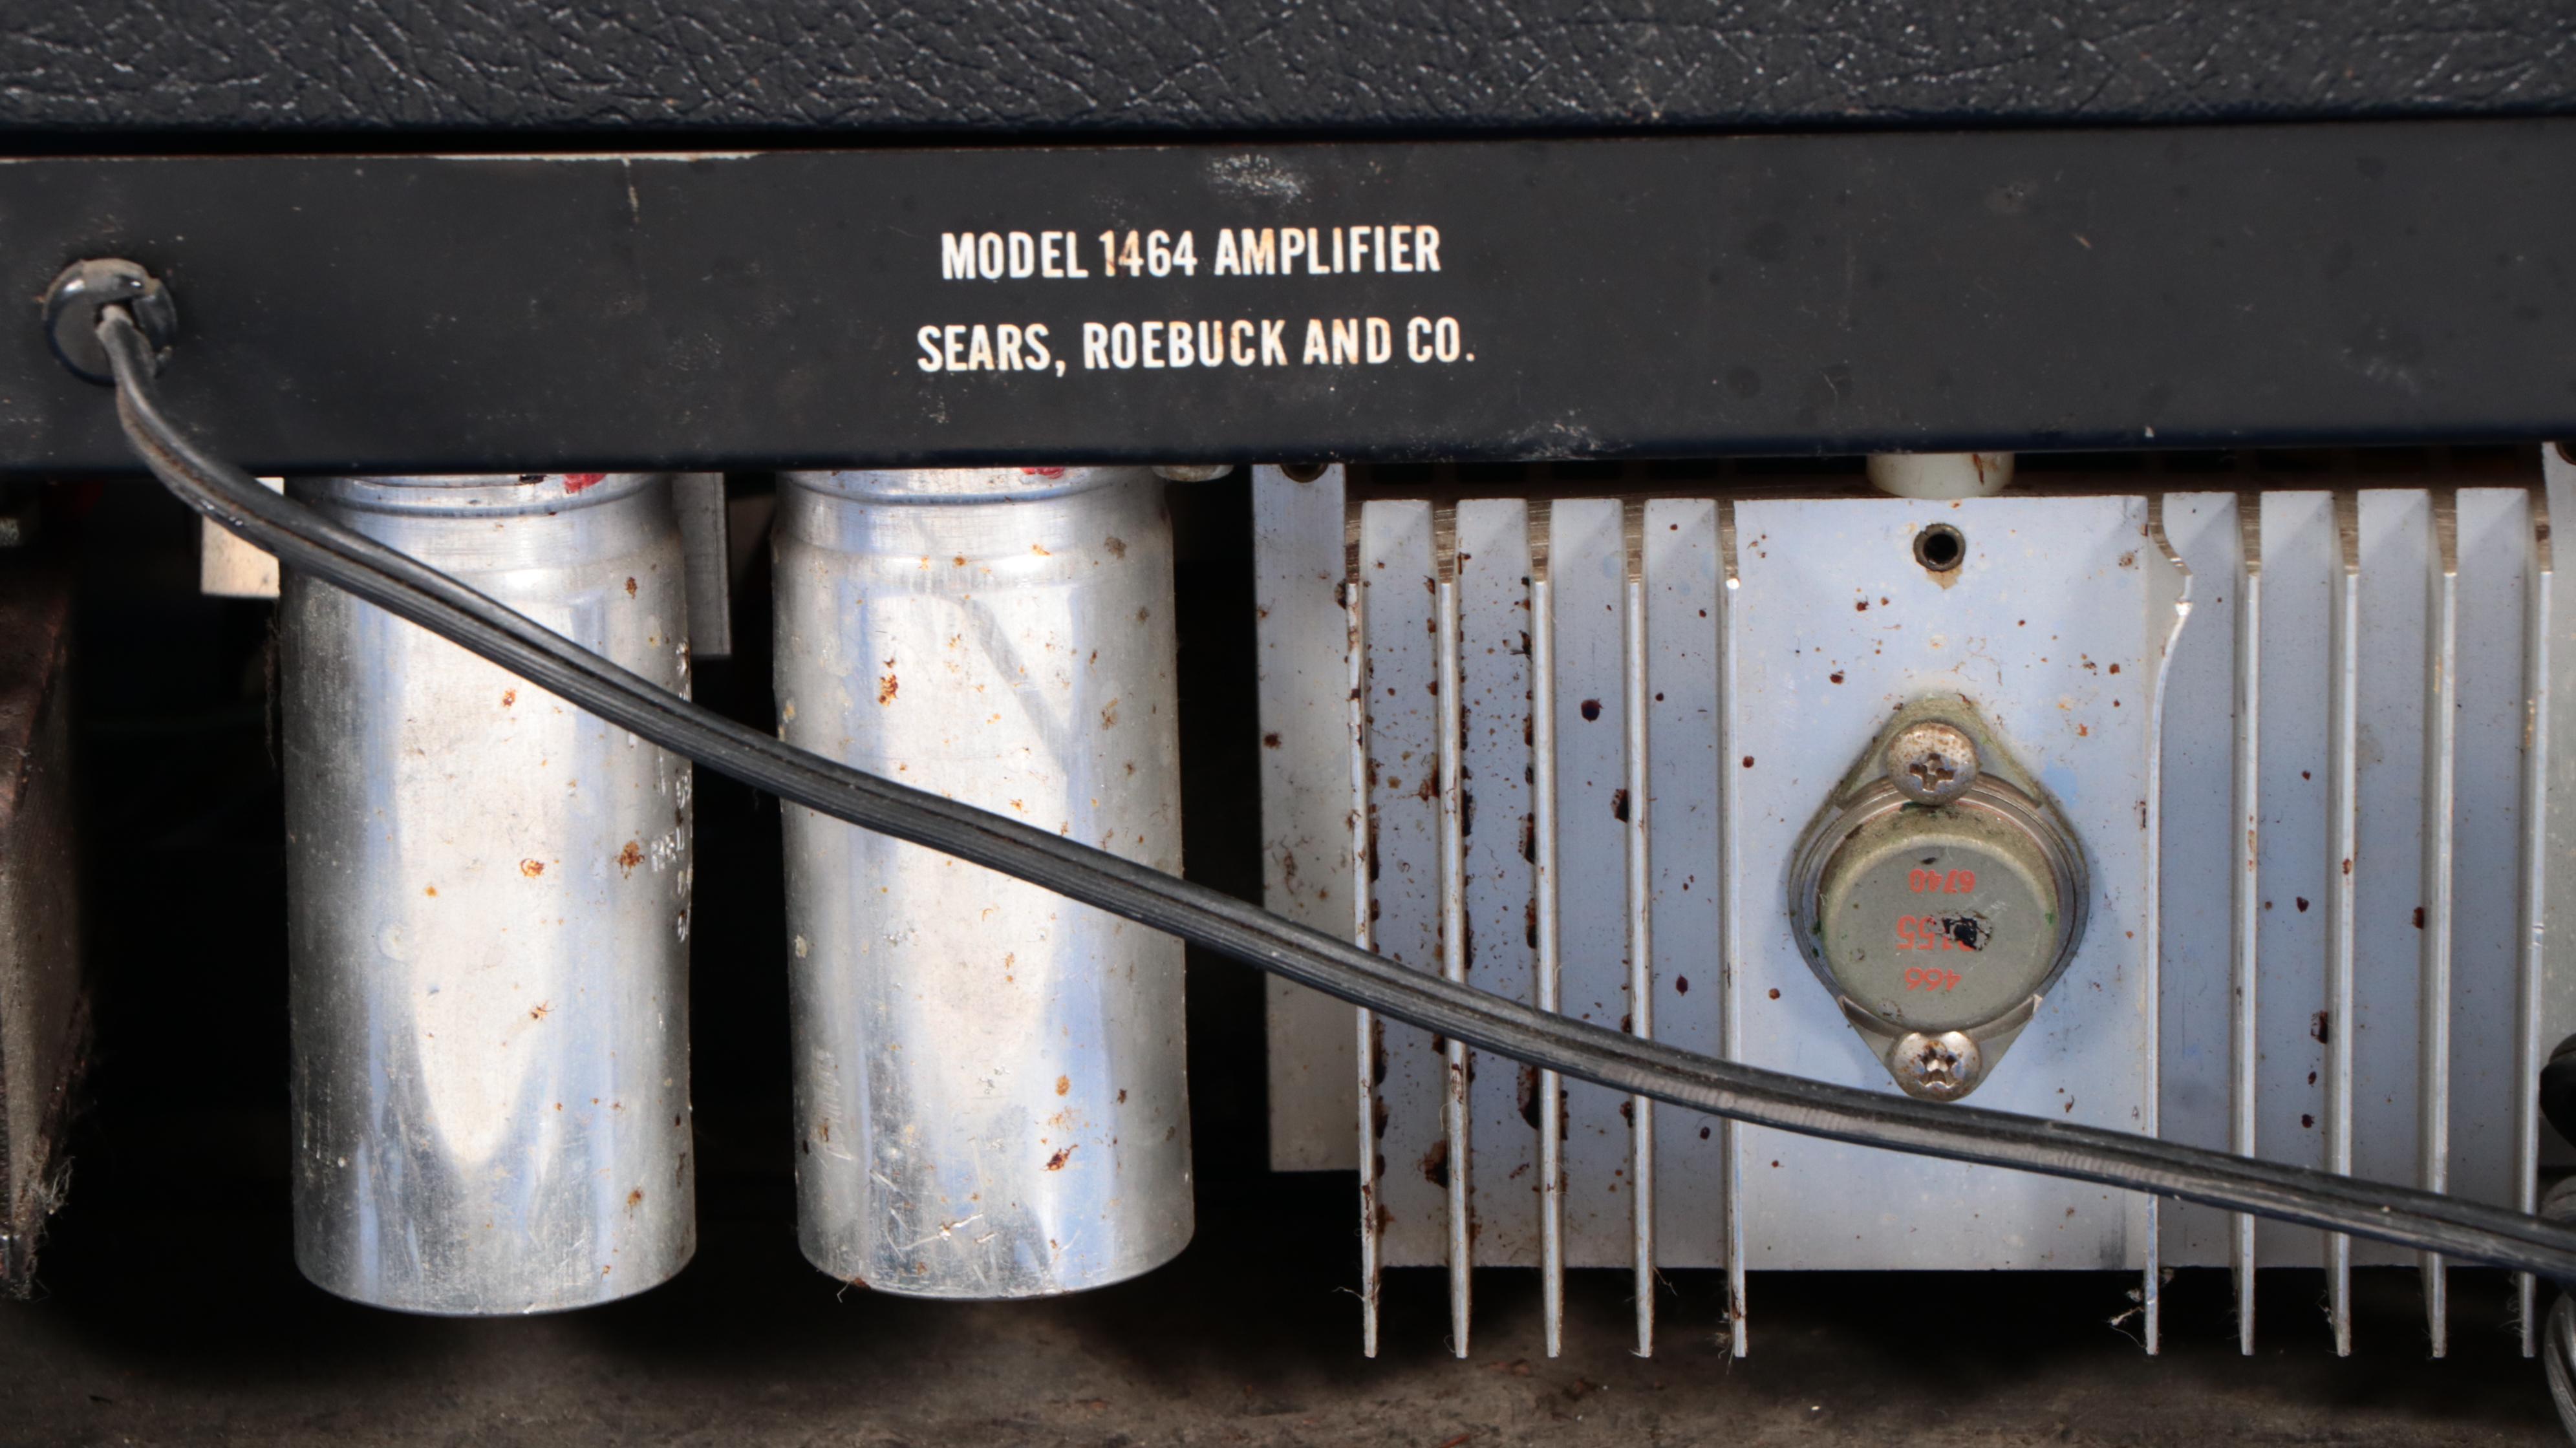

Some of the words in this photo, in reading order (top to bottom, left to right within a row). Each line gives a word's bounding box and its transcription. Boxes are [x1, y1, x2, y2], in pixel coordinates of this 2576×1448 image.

[941, 231, 1089, 280] MODEL
[1099, 229, 1198, 278] 1464
[1214, 225, 1442, 276] AMPLIFIER
[917, 323, 1066, 378] SEARS,
[1083, 319, 1288, 370] ROEBUCK
[1303, 317, 1391, 365] AND
[1407, 316, 1476, 363] CO.
[1908, 868, 1977, 894] 6740
[1904, 966, 1962, 992] 466
